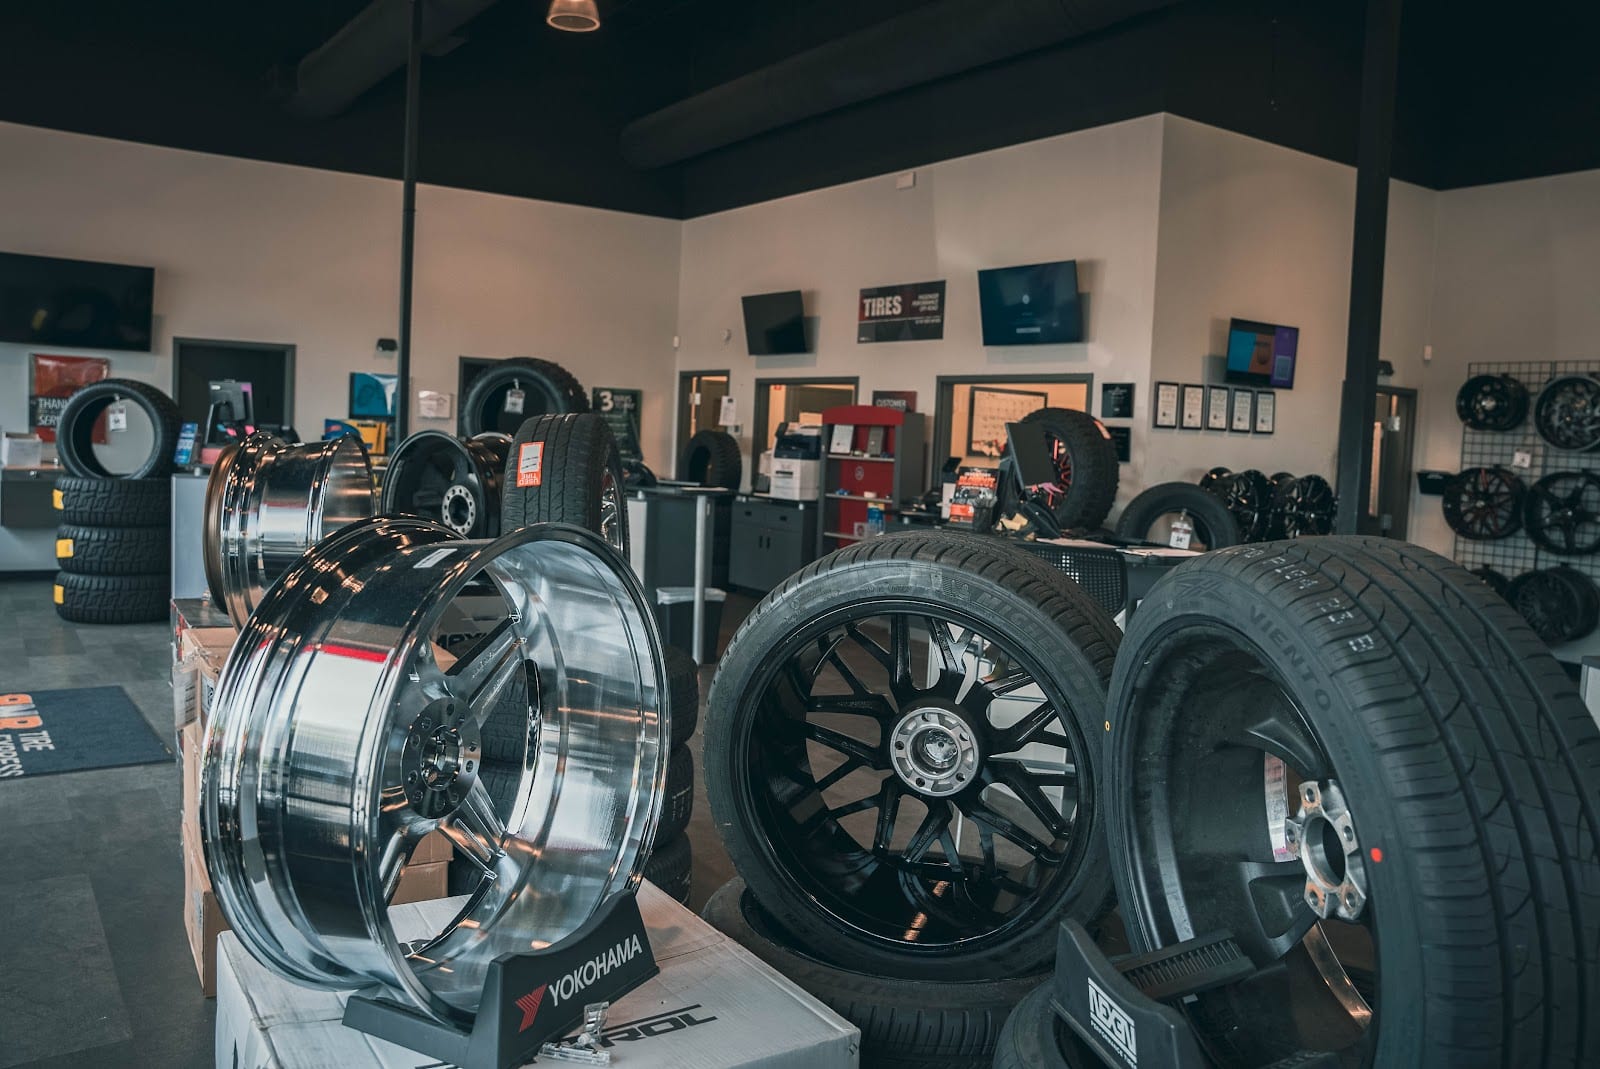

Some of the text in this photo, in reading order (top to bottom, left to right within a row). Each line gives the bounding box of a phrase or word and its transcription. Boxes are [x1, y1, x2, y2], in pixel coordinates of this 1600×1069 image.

[863, 295, 902, 317] TIRES
[599, 391, 614, 411] 3
[1250, 604, 1332, 712] VIENTO
[18, 730, 56, 752] TIRE
[548, 933, 643, 1008] YOKOHAMA
